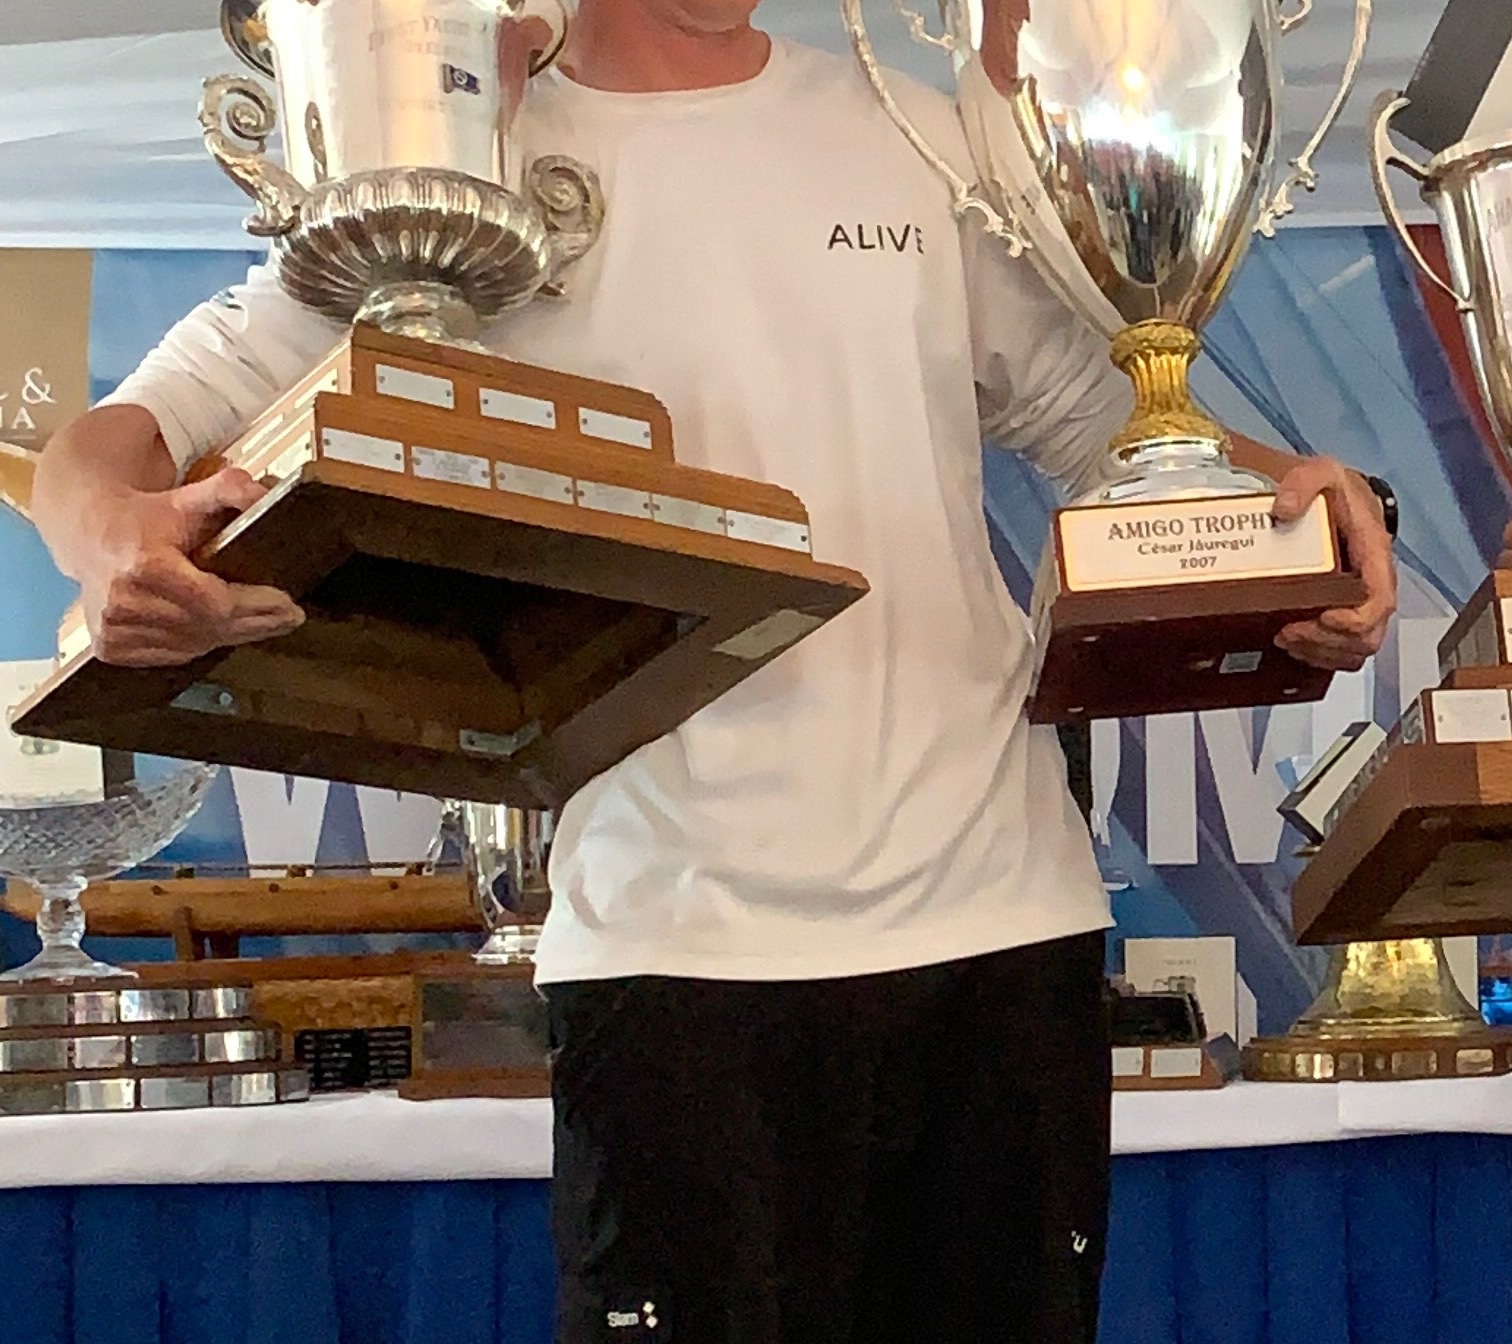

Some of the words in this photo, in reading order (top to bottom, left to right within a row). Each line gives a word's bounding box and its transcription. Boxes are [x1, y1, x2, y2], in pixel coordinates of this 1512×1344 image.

[21, 366, 58, 405] &
[1107, 518, 1185, 541] AMIGO
[1189, 511, 1279, 535] TROPHY
[1137, 542, 1184, 556] César
[1179, 556, 1218, 570] 2007
